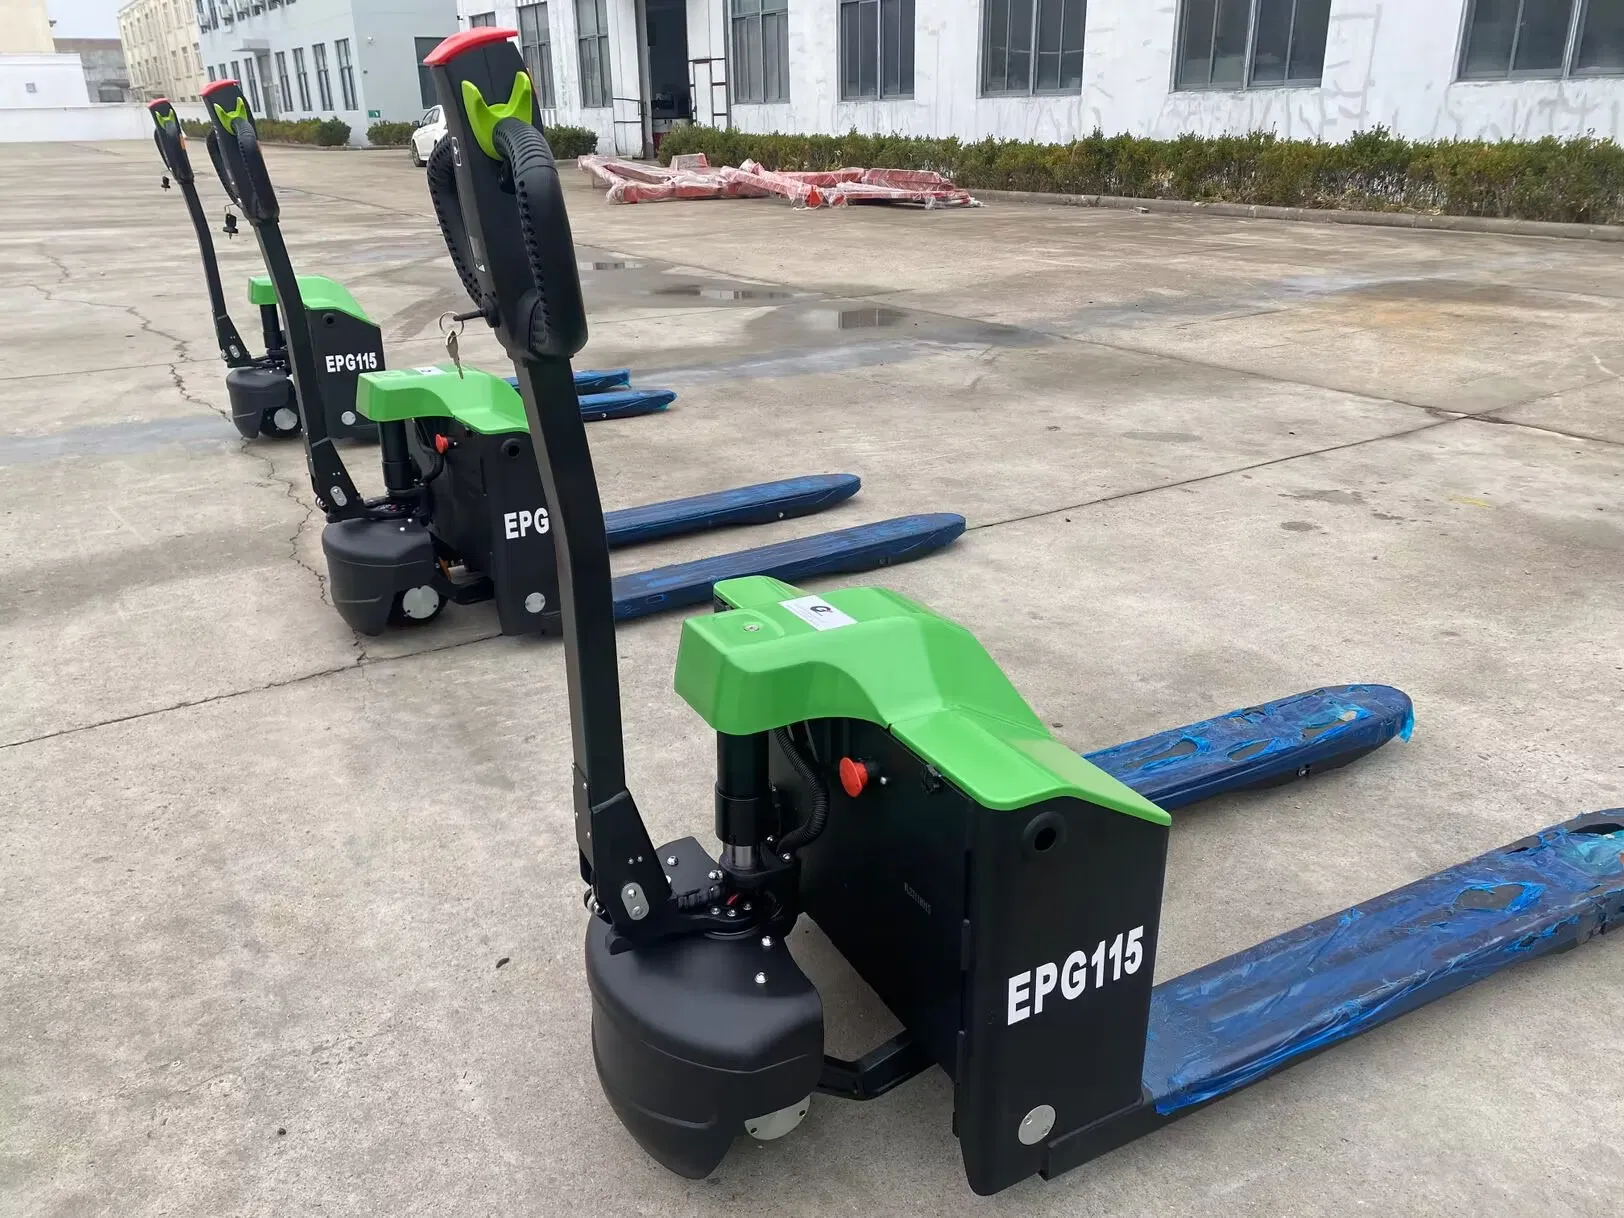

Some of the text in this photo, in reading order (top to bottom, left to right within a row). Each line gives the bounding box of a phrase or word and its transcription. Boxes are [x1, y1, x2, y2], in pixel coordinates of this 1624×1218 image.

[325, 352, 377, 372] EPG115
[504, 507, 549, 539] EPG
[1008, 925, 1144, 1025] EPG115
